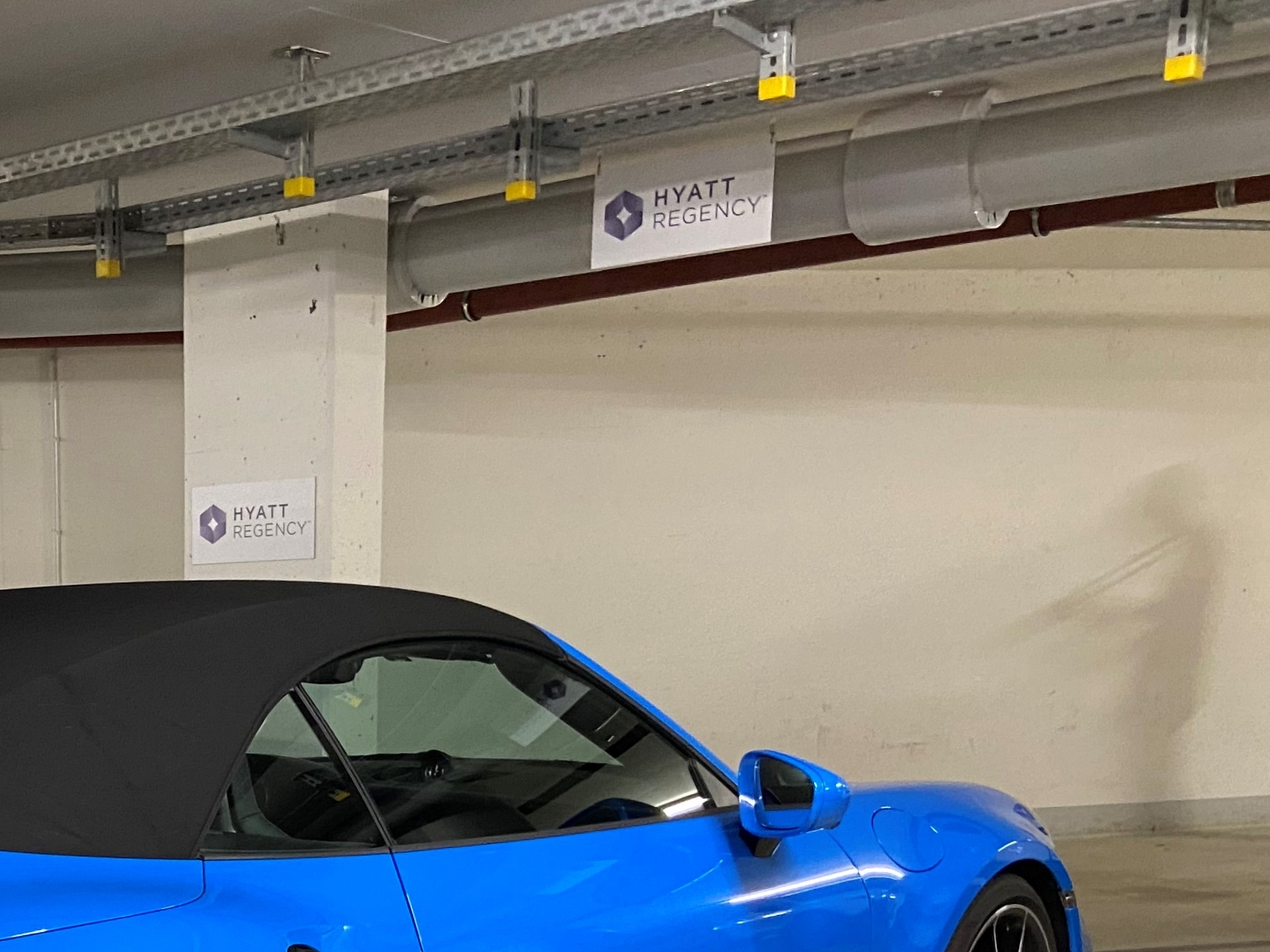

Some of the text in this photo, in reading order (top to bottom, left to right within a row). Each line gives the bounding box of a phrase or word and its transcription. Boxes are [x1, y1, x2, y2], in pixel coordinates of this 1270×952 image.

[654, 177, 735, 207] HYATT
[653, 195, 764, 230] REGENCY
[233, 503, 289, 521] HYATT
[233, 521, 309, 539] REGENCY
